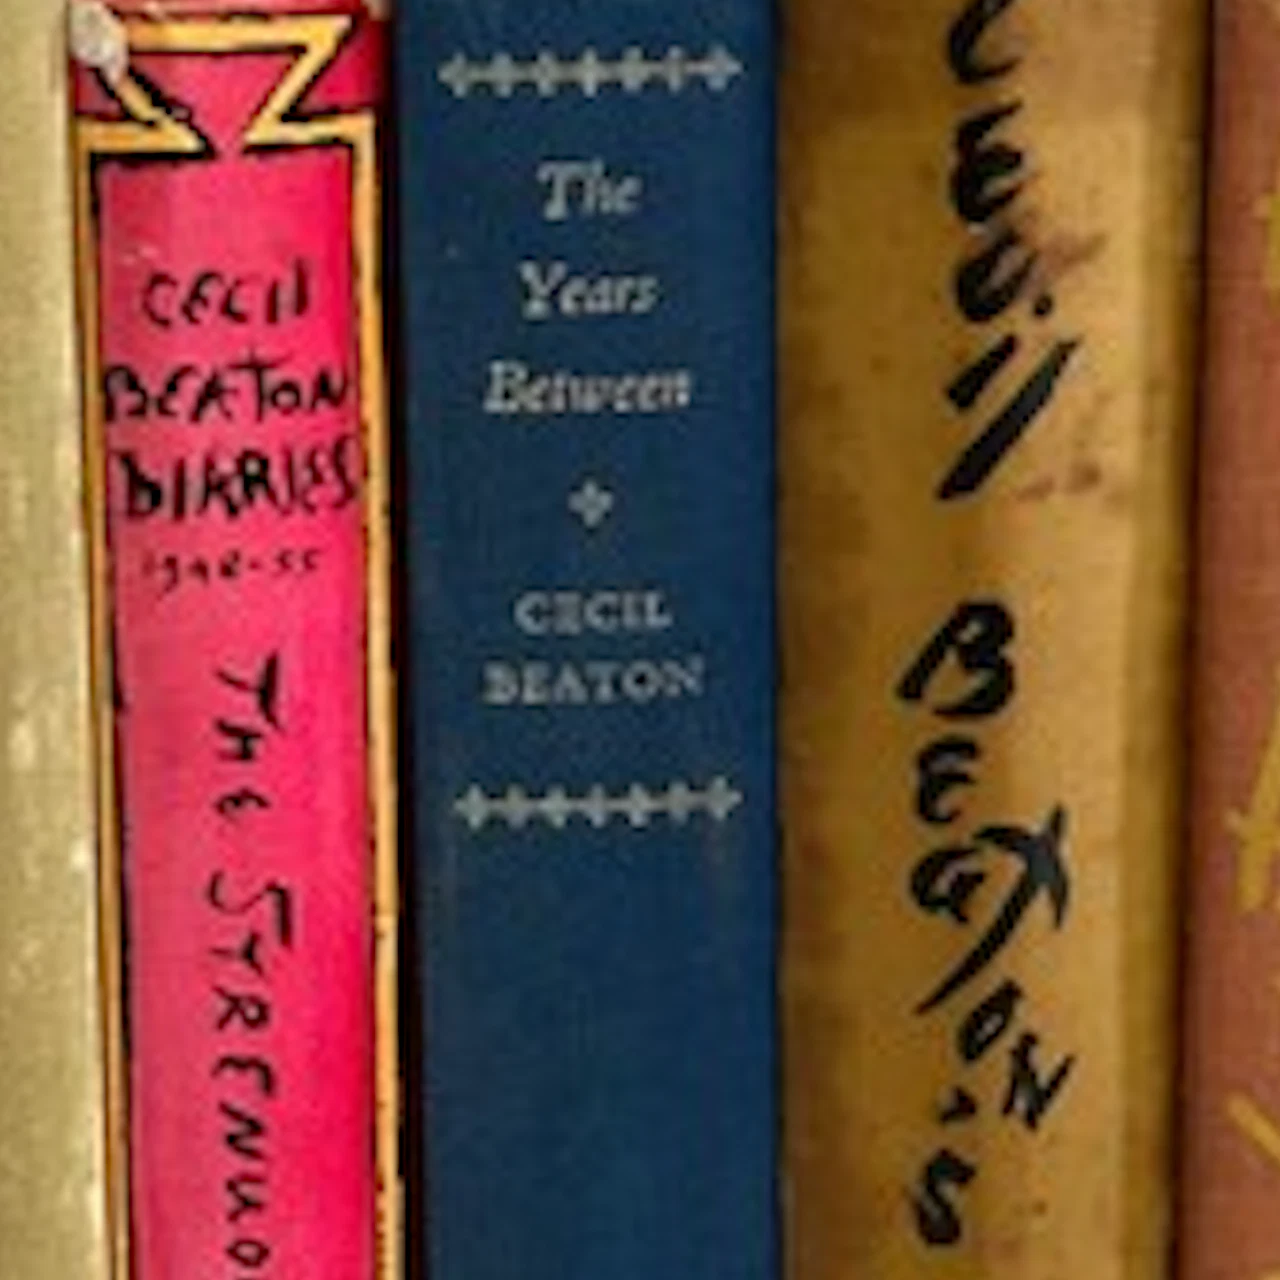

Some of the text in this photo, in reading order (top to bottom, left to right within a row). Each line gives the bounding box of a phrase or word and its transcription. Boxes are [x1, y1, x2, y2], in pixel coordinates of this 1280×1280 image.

[536, 158, 643, 222] The
[520, 260, 658, 319] Years
[483, 359, 691, 416] Between
[514, 590, 672, 636] CECIL
[485, 656, 704, 704] BEATON
